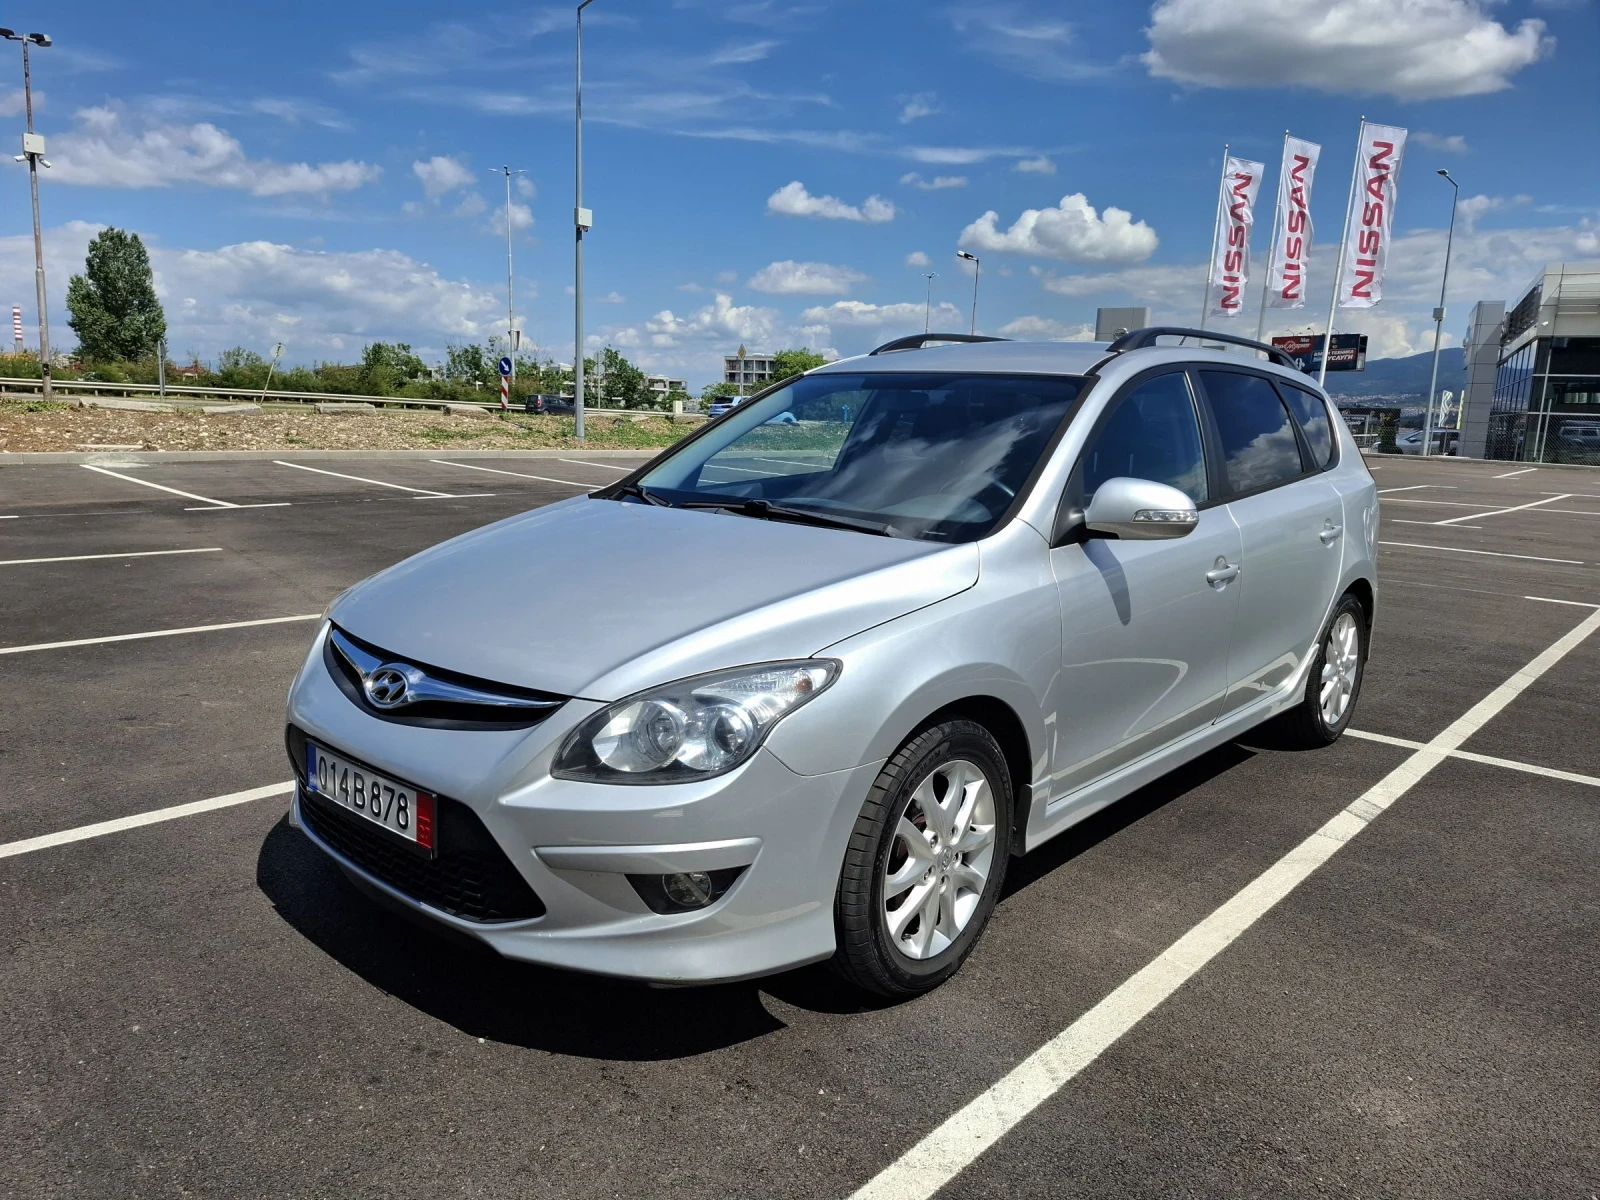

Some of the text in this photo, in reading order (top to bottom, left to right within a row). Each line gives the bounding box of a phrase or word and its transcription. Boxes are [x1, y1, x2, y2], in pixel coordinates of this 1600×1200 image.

[1221, 172, 1252, 309] NISSAN
[1282, 154, 1309, 299] NISSAN
[1351, 141, 1394, 298] NISSAN
[318, 755, 410, 830] 014B878
